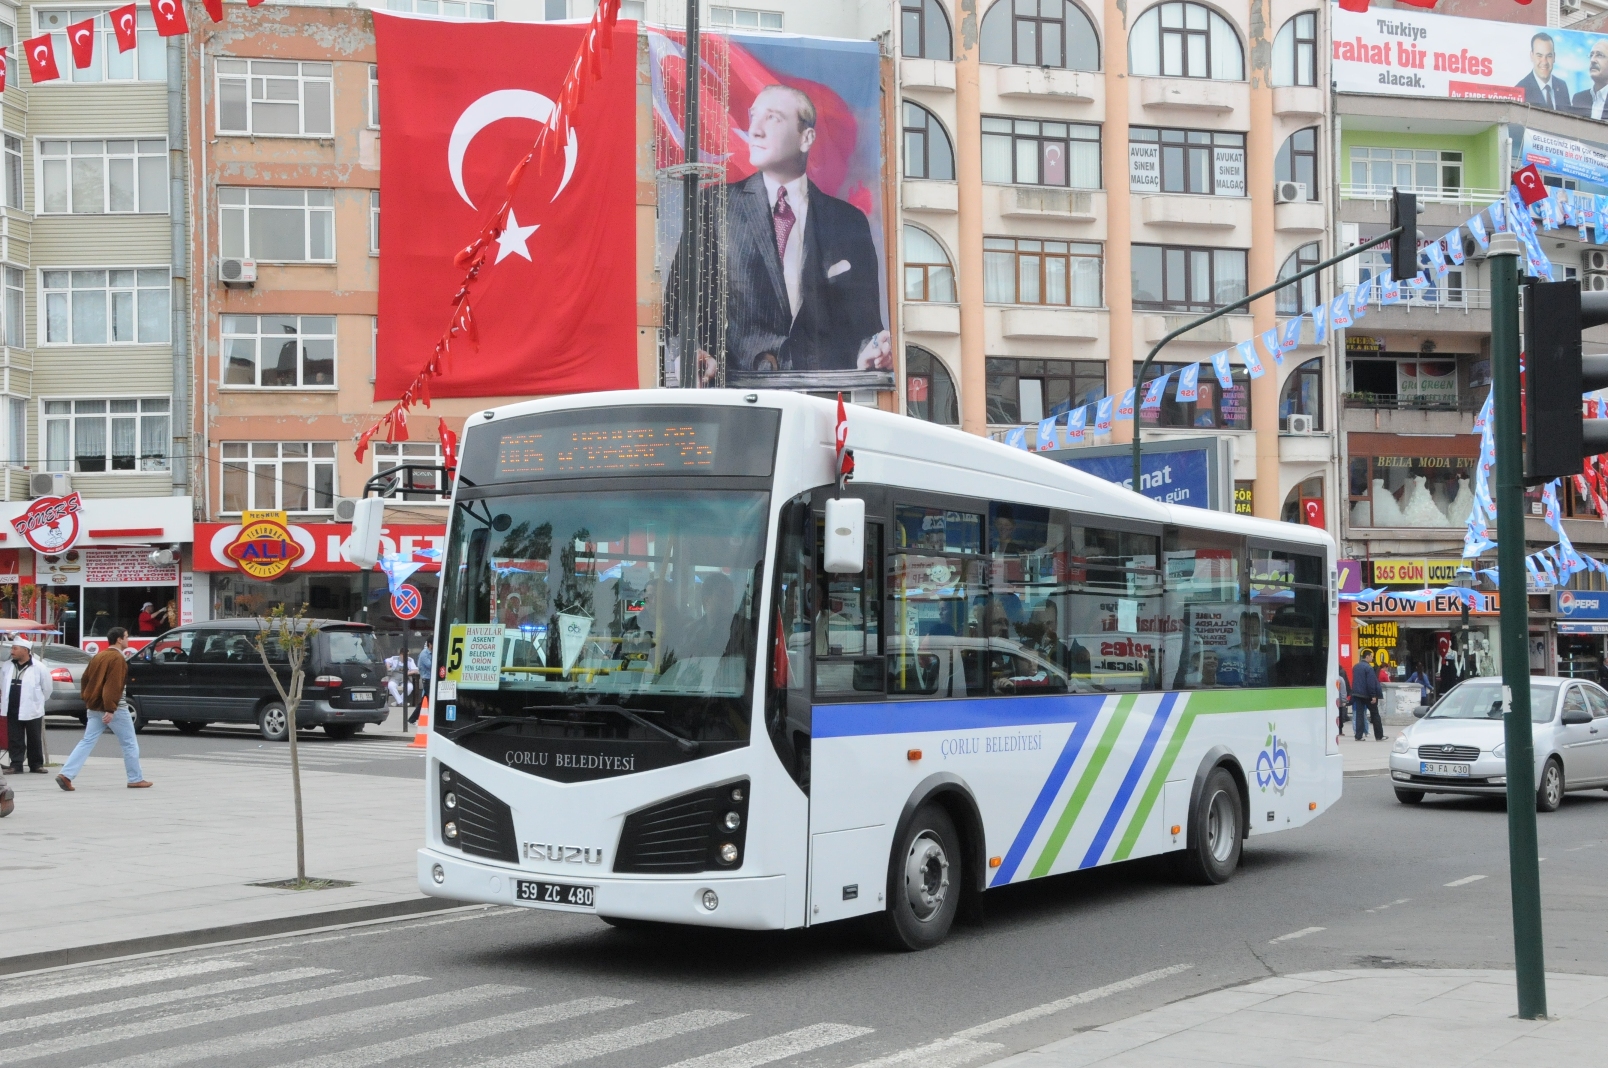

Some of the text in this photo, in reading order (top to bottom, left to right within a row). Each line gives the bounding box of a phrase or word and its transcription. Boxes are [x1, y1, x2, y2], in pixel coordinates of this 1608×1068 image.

[1377, 19, 1427, 41] Türkiye
[1332, 36, 1493, 77] rahat bir nefes
[1378, 70, 1426, 89] alacak.
[1130, 147, 1158, 158] AVUKAT
[1532, 143, 1543, 152] HER
[1545, 145, 1564, 157] EVDEN
[1215, 152, 1243, 163] AVUKAT
[1130, 175, 1159, 187] MALGAÇ
[1215, 179, 1244, 192] MALGAÇ
[1421, 379, 1454, 391] GREEN
[1377, 456, 1413, 468] BELLA
[1418, 456, 1451, 468] MODA
[1165, 487, 1190, 504] gün
[1235, 504, 1251, 512] AFA
[1376, 562, 1424, 580] 365 GÜN
[1357, 596, 1417, 612] SHOW
[1574, 599, 1600, 609] PEPSI
[466, 627, 502, 636] HAVUZLAR
[1375, 621, 1398, 638] SEZON
[1359, 636, 1397, 647] ELBİSELER
[941, 730, 1042, 760] ÇORLU BELEDİYESİ
[505, 751, 635, 771] ÇORLU BELEDİYESİ
[1425, 763, 1468, 774] 59 FA 430
[522, 841, 603, 866] ISUZU
[521, 882, 593, 906] 59 ZC 480
